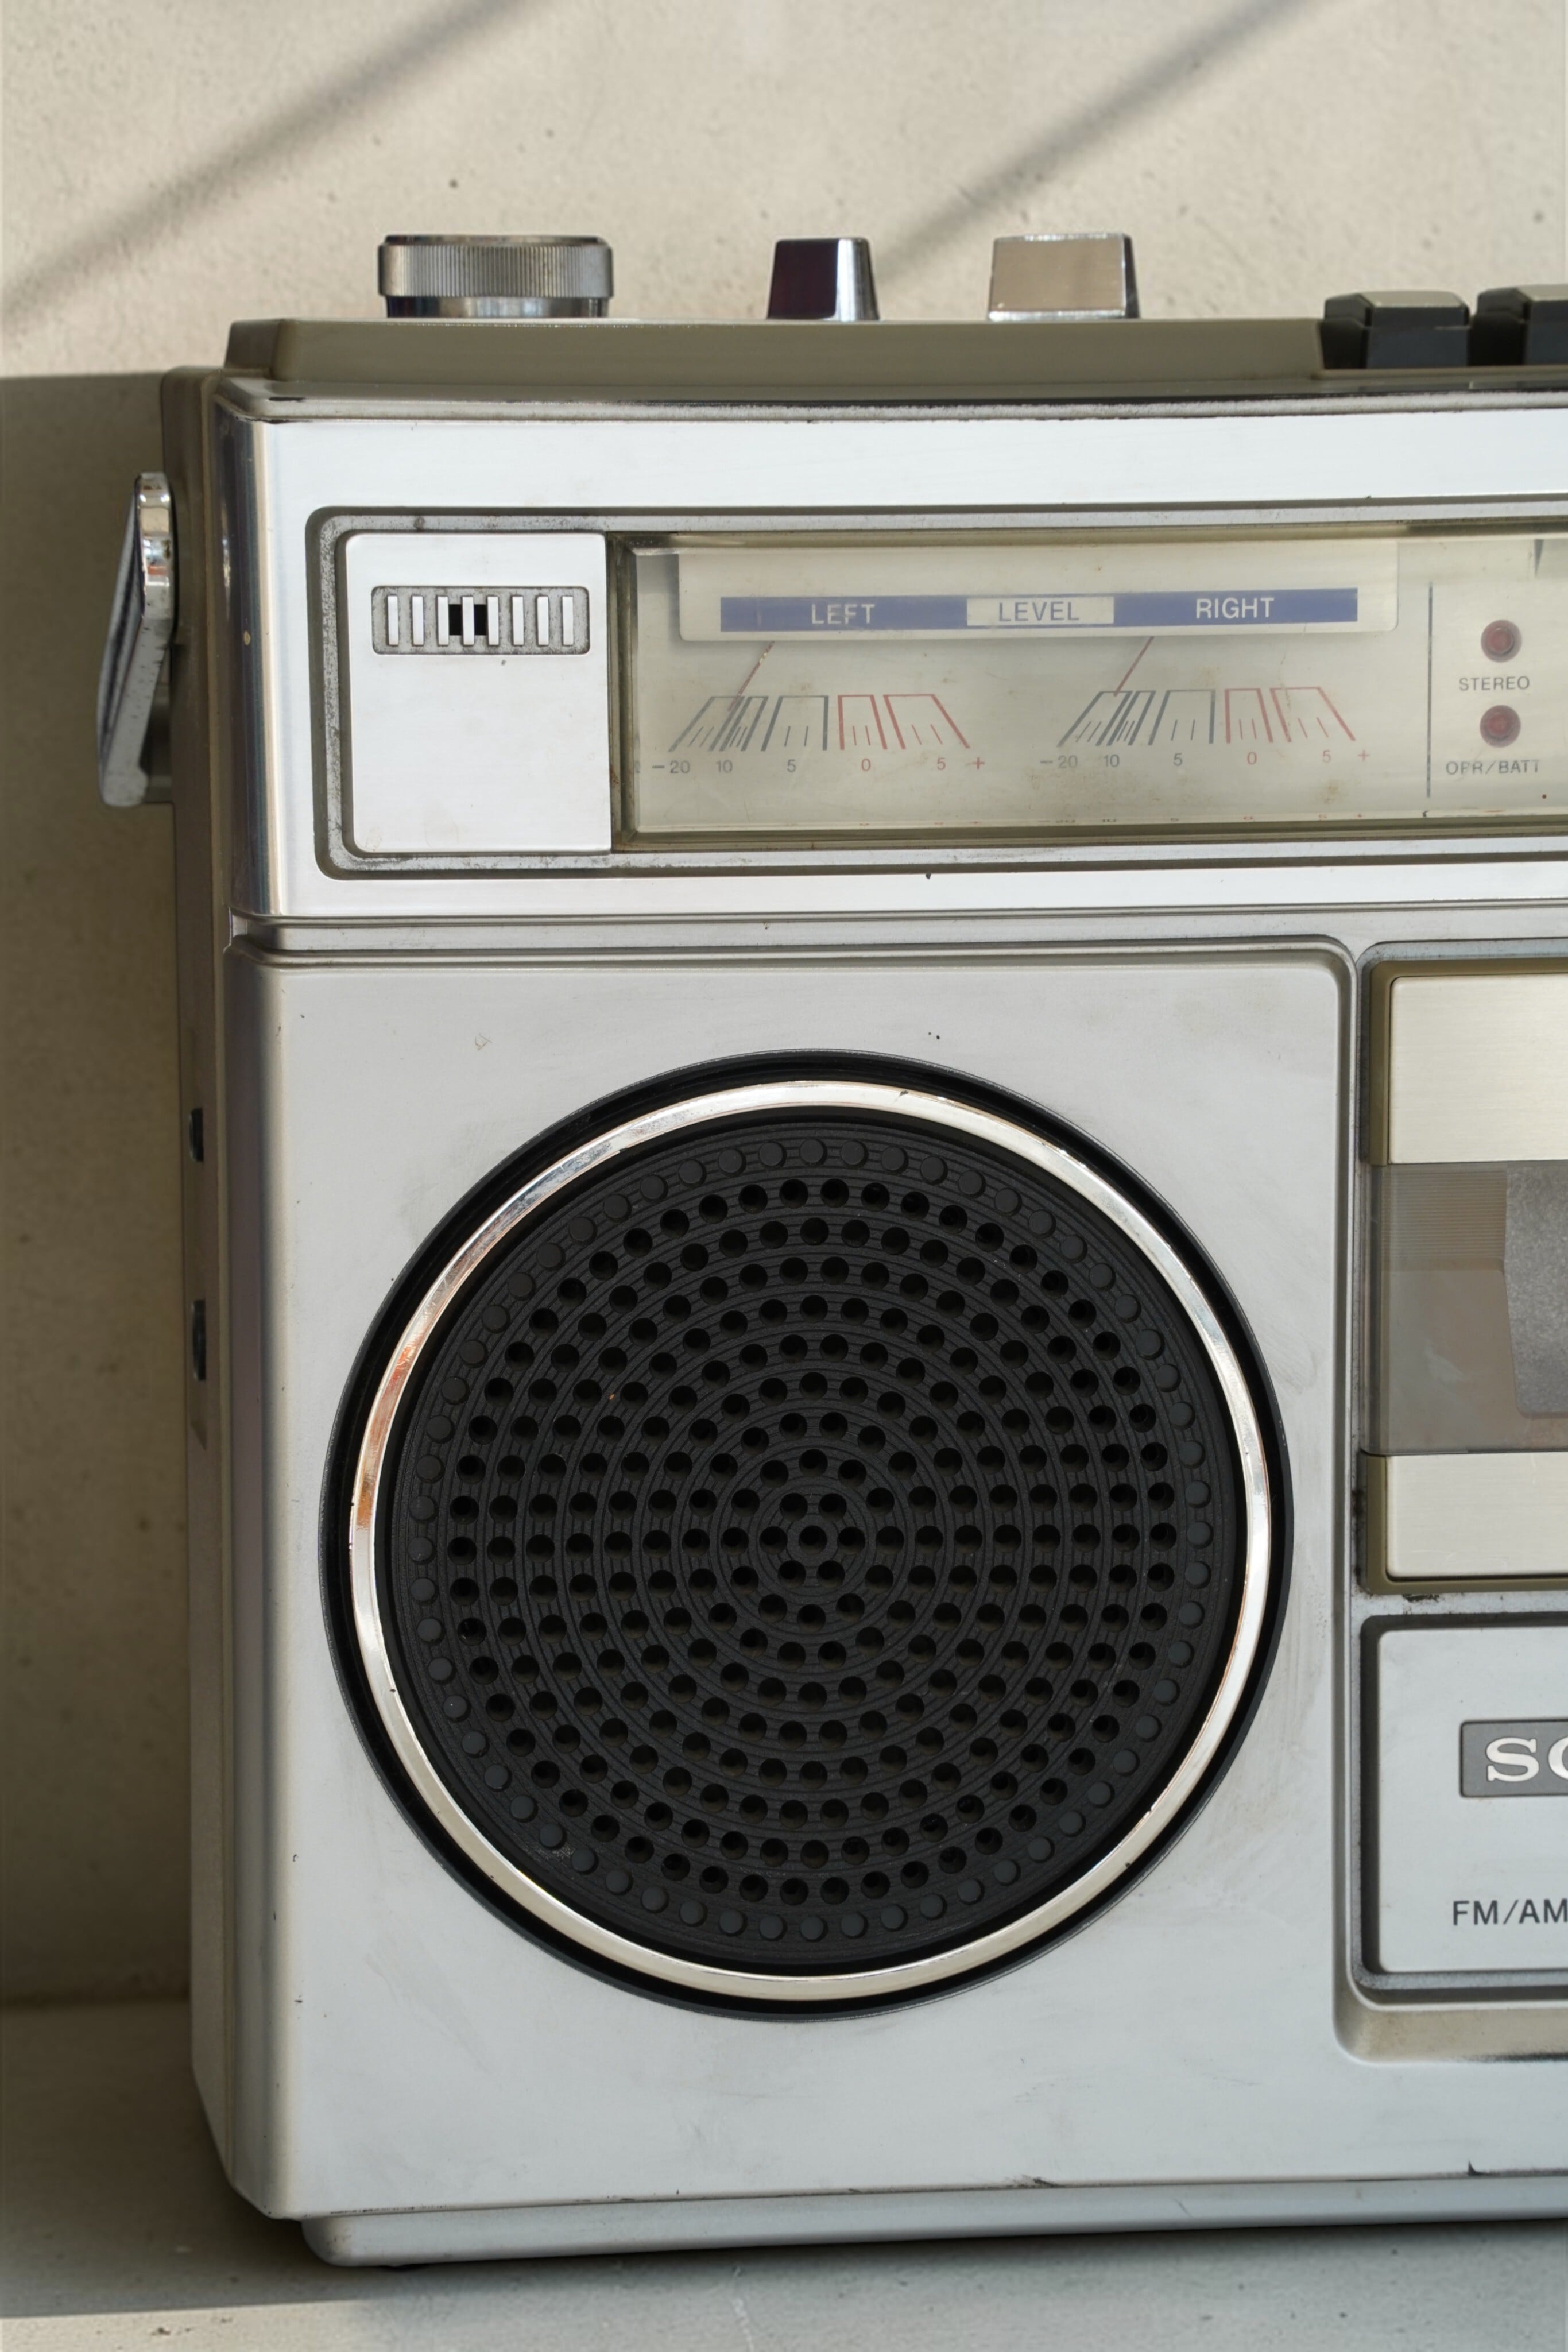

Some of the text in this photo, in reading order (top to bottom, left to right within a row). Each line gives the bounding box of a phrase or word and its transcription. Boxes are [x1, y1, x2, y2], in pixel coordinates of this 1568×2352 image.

[811, 603, 874, 625] LEFT
[998, 601, 1080, 622] LEVEL
[1195, 597, 1274, 620] RIGHT
[1459, 675, 1530, 691] STEREO
[716, 760, 733, 773] 10
[787, 759, 796, 772] 5
[861, 758, 872, 772] 0
[936, 757, 946, 771] 5
[1103, 754, 1120, 768] 10
[1173, 753, 1183, 767] 5
[1246, 751, 1257, 765] 0
[1322, 749, 1332, 763] 5
[1445, 759, 1540, 775] OPR/BATT
[1453, 1898, 1568, 1926] FM/AM
